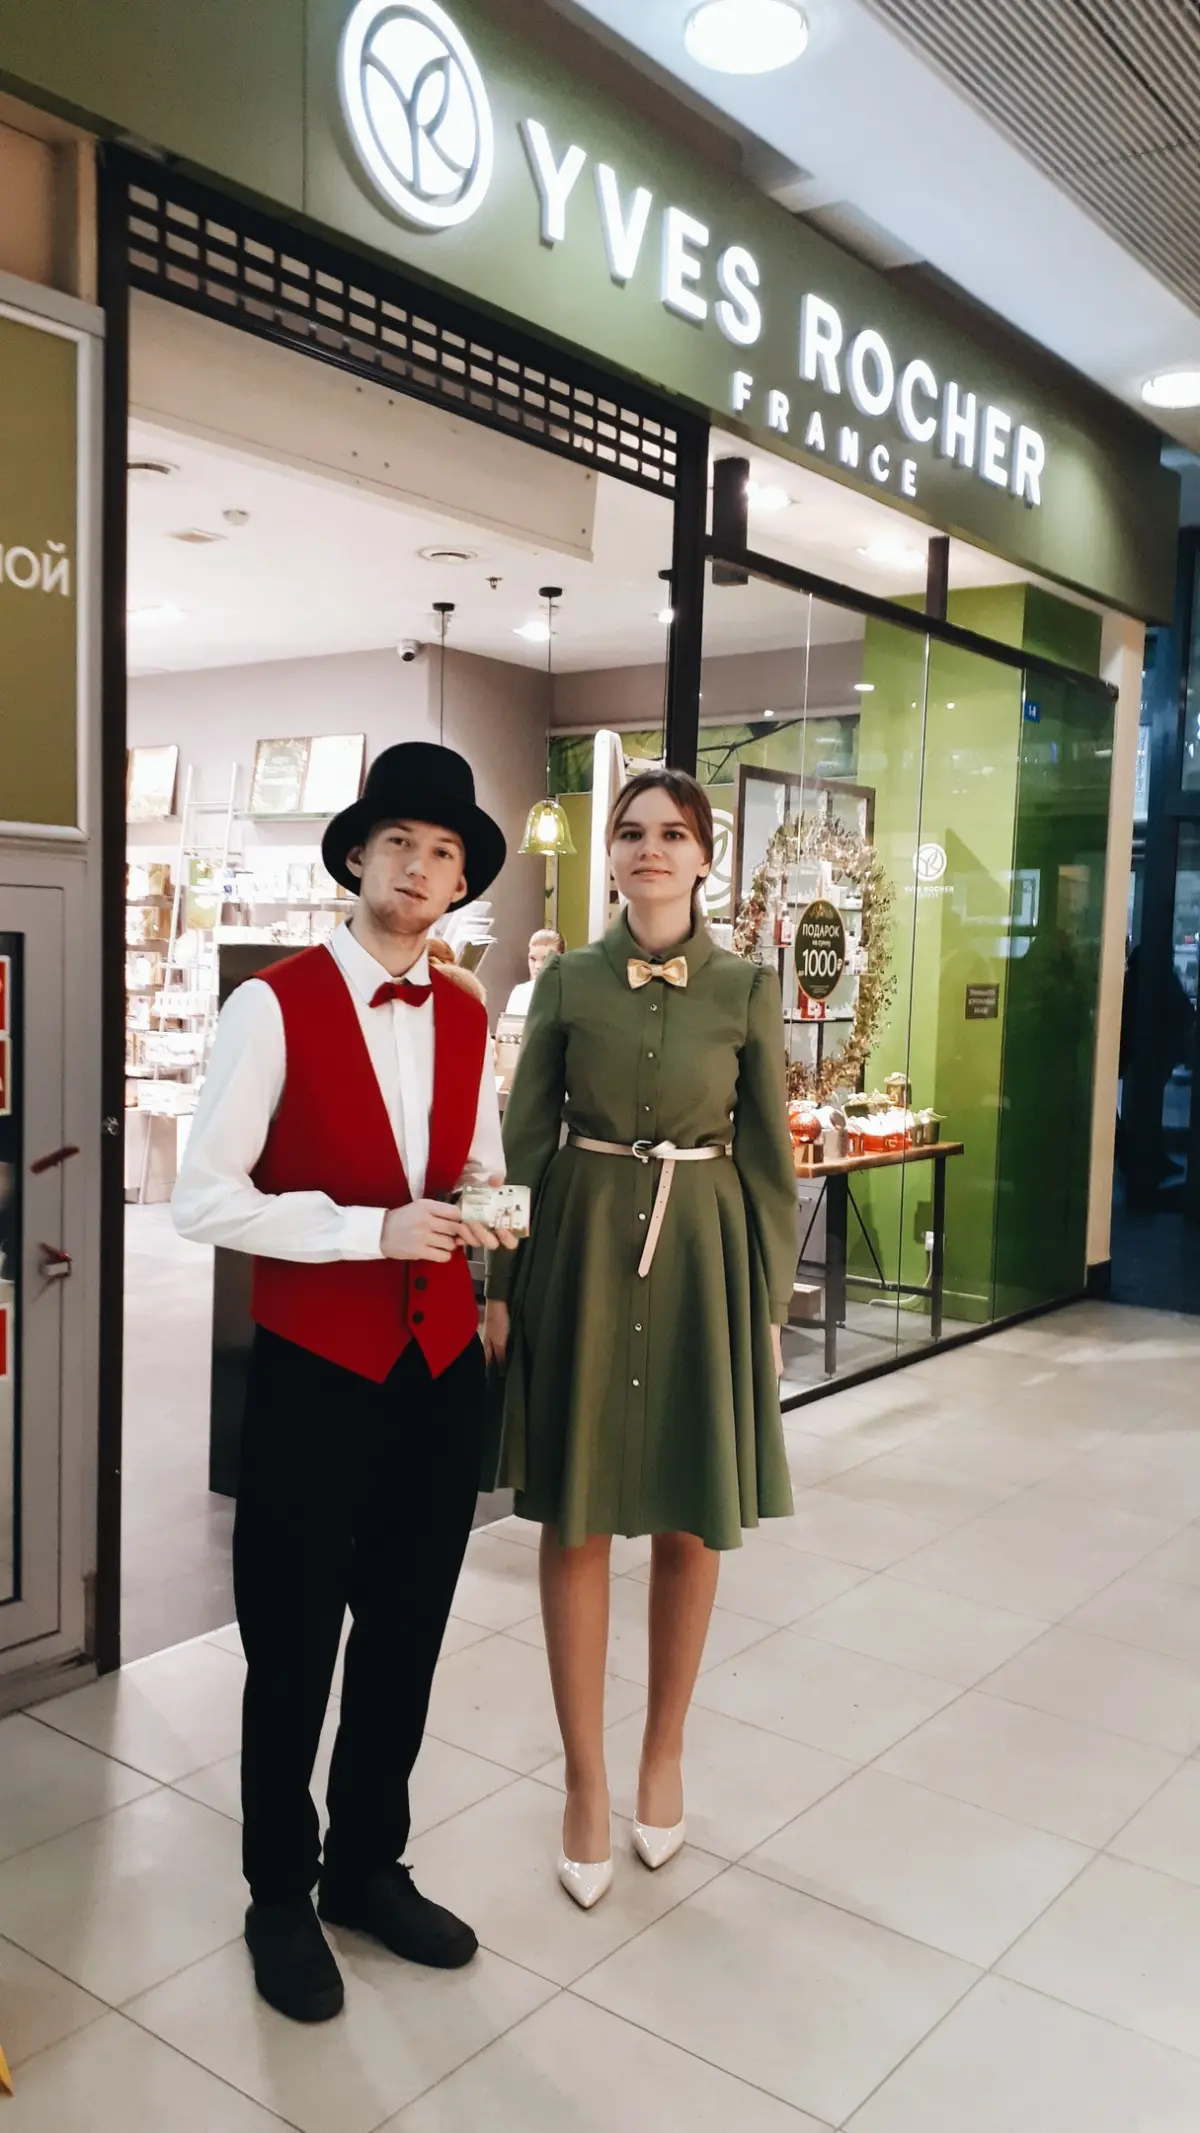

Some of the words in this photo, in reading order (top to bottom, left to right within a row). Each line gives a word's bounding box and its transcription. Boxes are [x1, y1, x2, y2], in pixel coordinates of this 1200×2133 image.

[523, 117, 762, 345] YVES
[800, 292, 1045, 506] ROCHER
[732, 370, 918, 498] FRANCE
[802, 923, 840, 938] ПОДАРОК
